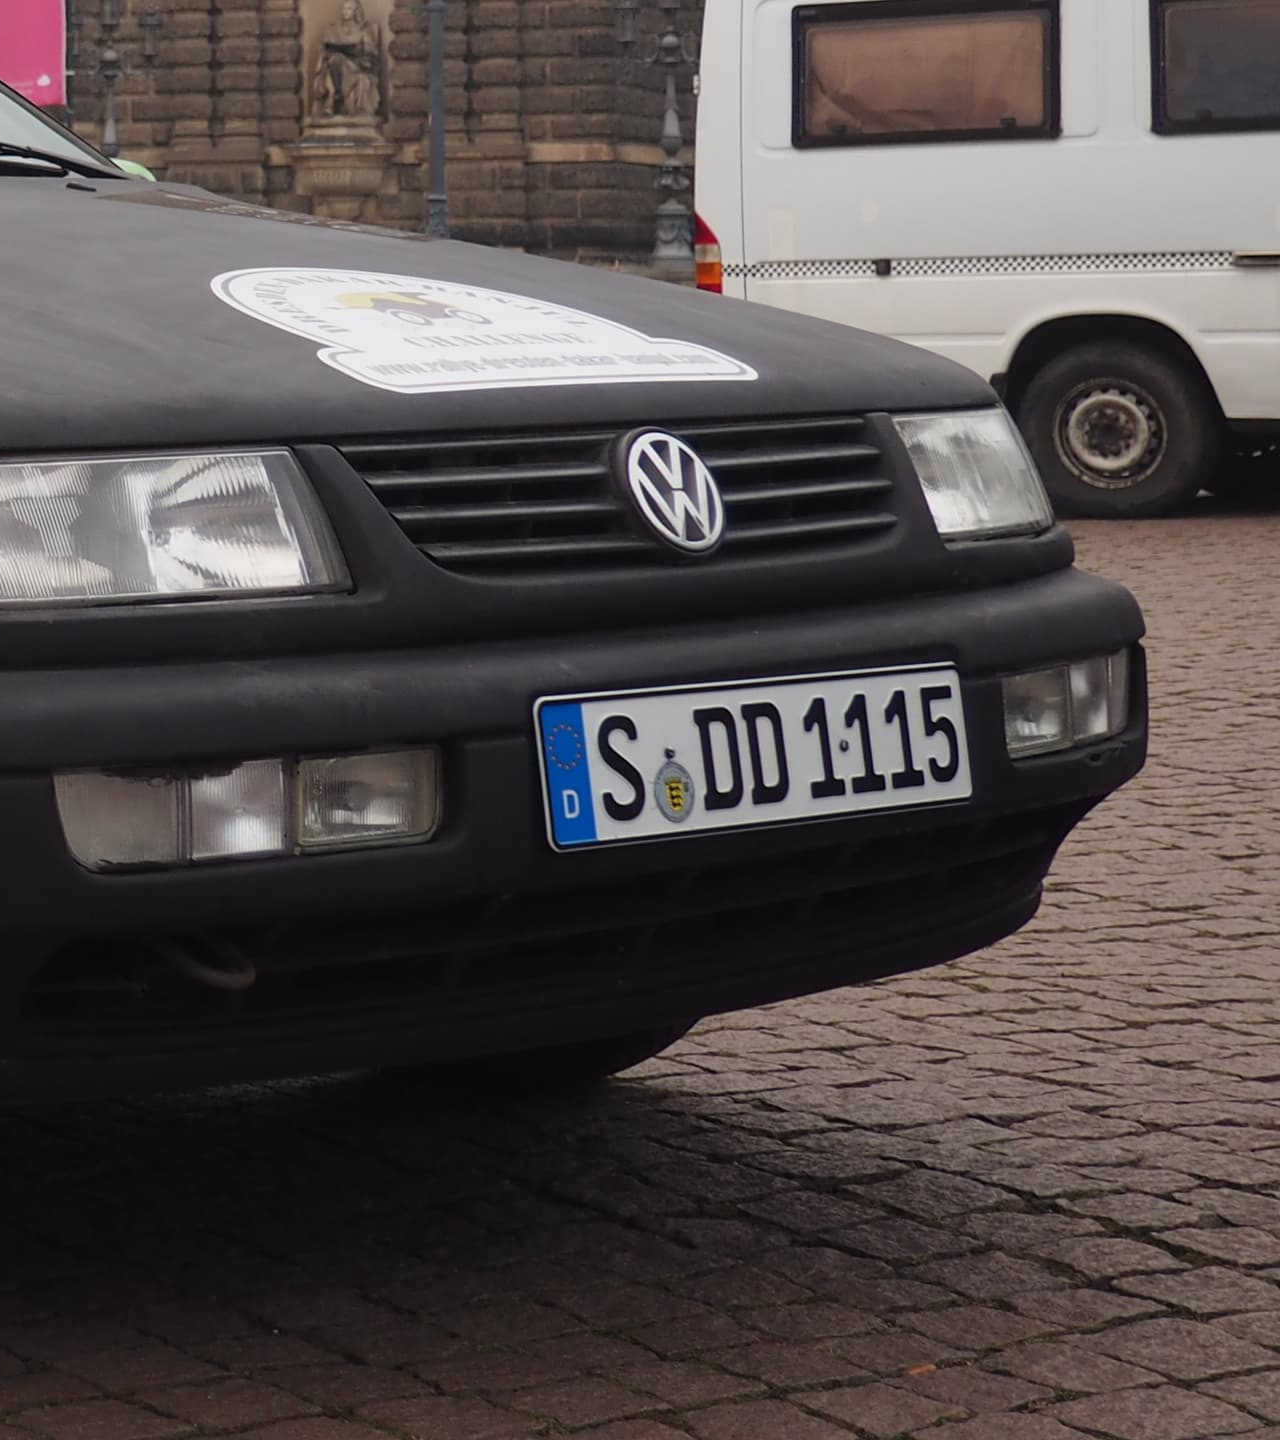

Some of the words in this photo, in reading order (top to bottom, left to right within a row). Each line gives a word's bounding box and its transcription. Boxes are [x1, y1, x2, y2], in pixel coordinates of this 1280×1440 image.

[596, 714, 646, 822] S
[692, 702, 790, 811] DD
[802, 684, 960, 800] 1115
[561, 789, 581, 819] D
